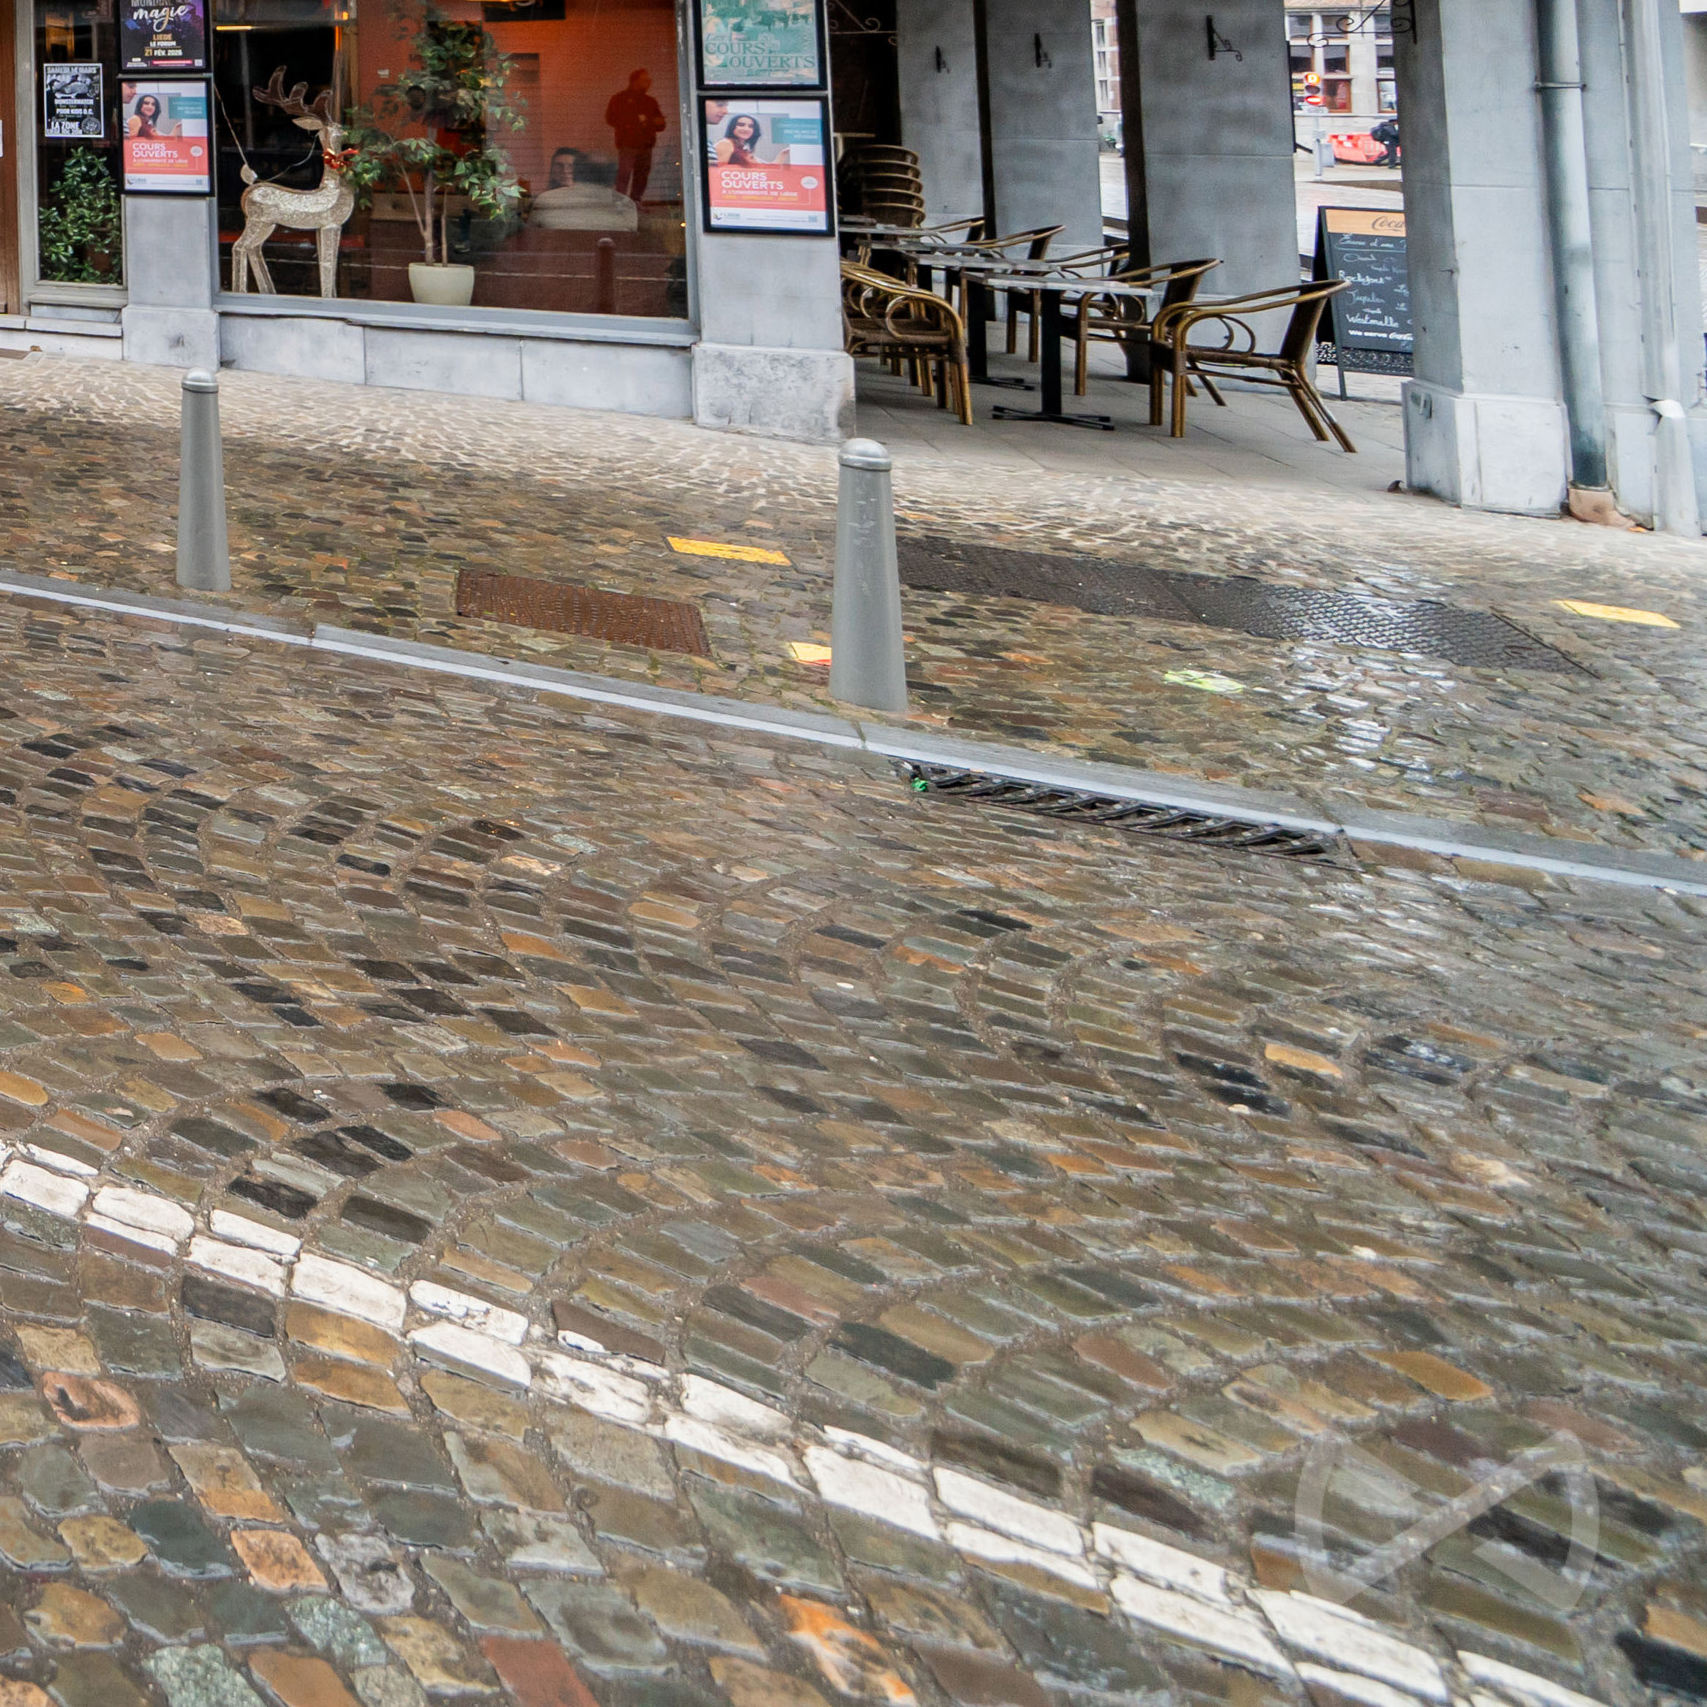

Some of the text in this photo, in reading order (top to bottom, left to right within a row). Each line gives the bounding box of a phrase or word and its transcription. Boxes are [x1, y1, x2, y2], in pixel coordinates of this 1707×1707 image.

[133, 5, 188, 32] magie
[705, 42, 765, 54] COURS
[729, 56, 815, 68] OUVERTS
[132, 142, 166, 150] COURS
[132, 150, 178, 158] OUVERTS
[721, 171, 767, 180] COURS
[721, 180, 784, 190] OUVERTS
